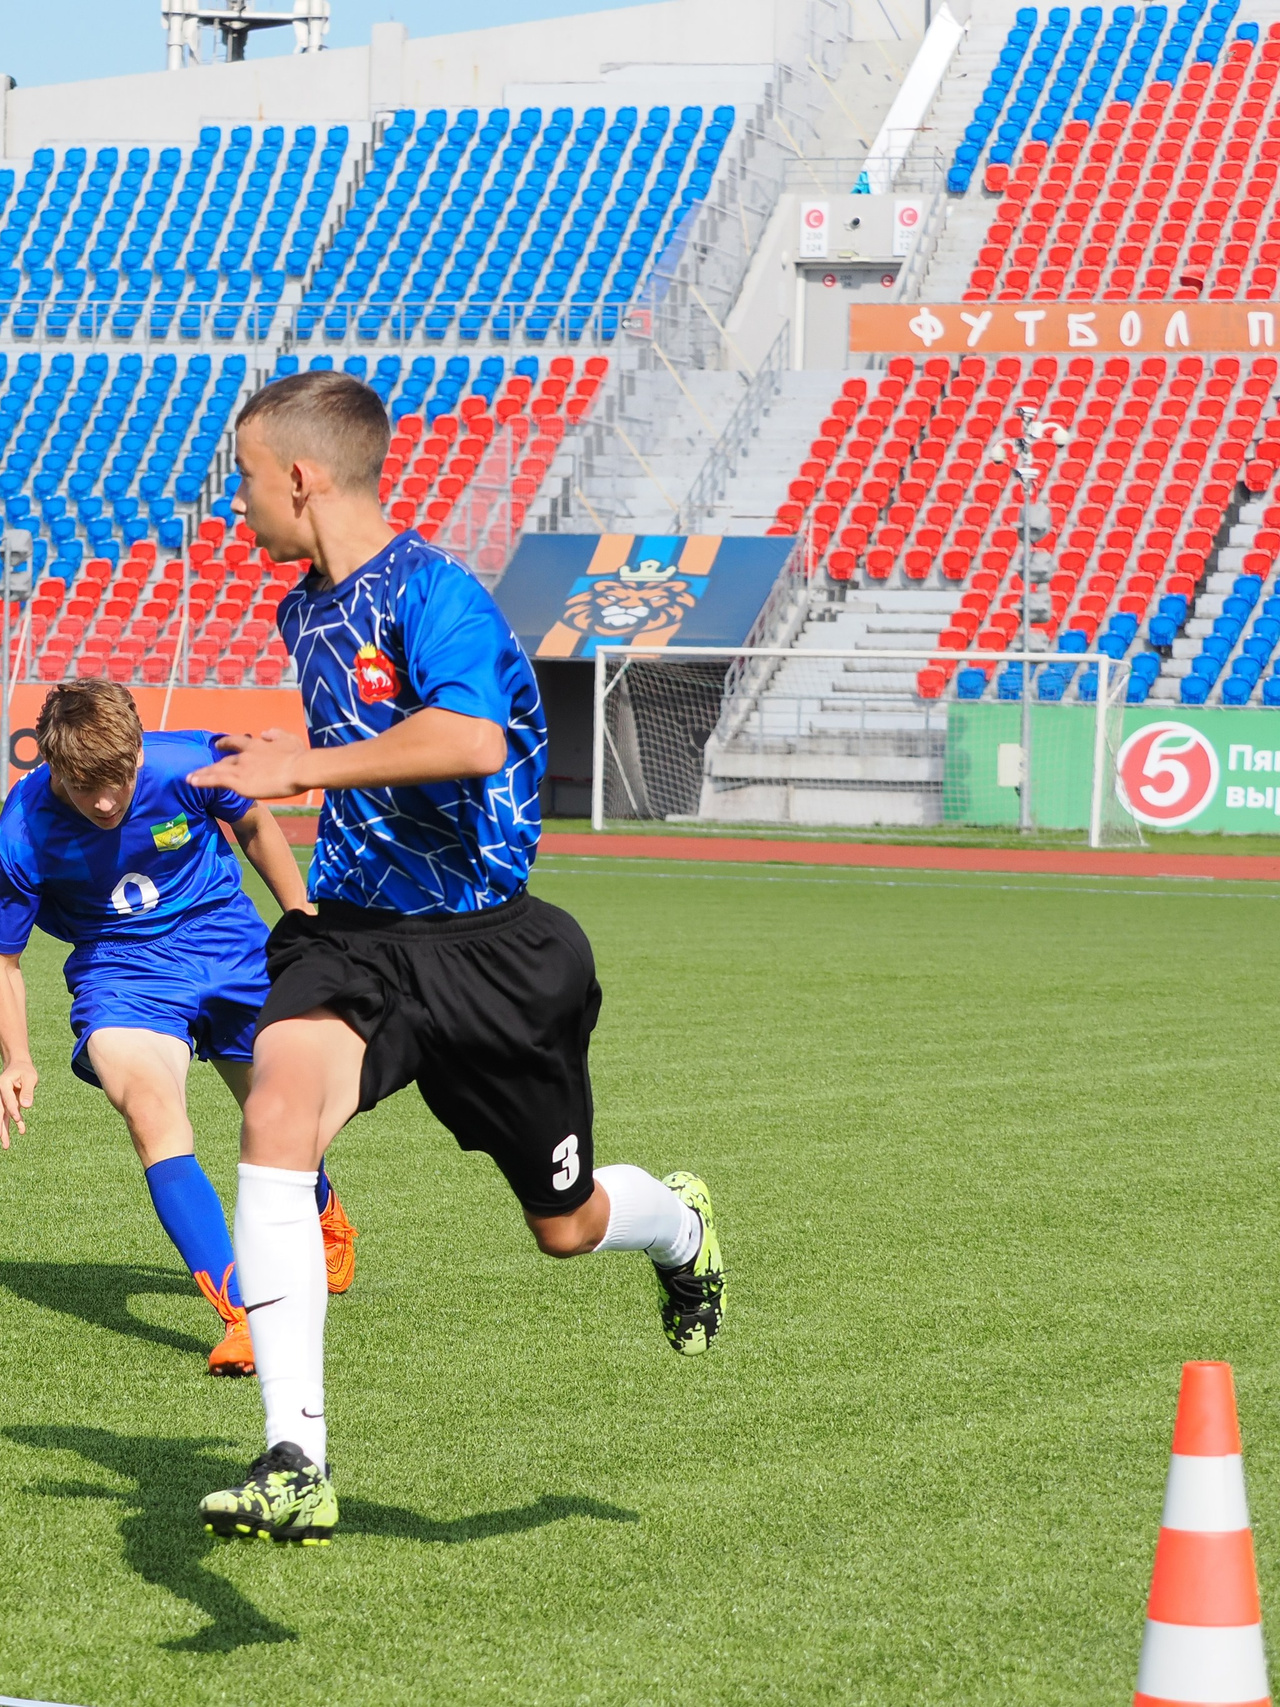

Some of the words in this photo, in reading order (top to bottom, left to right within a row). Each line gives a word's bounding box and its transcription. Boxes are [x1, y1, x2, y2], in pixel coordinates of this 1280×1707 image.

[909, 307, 1189, 347] ФУТБОЛ
[1140, 729, 1198, 807] 5
[552, 1134, 580, 1191] 3
